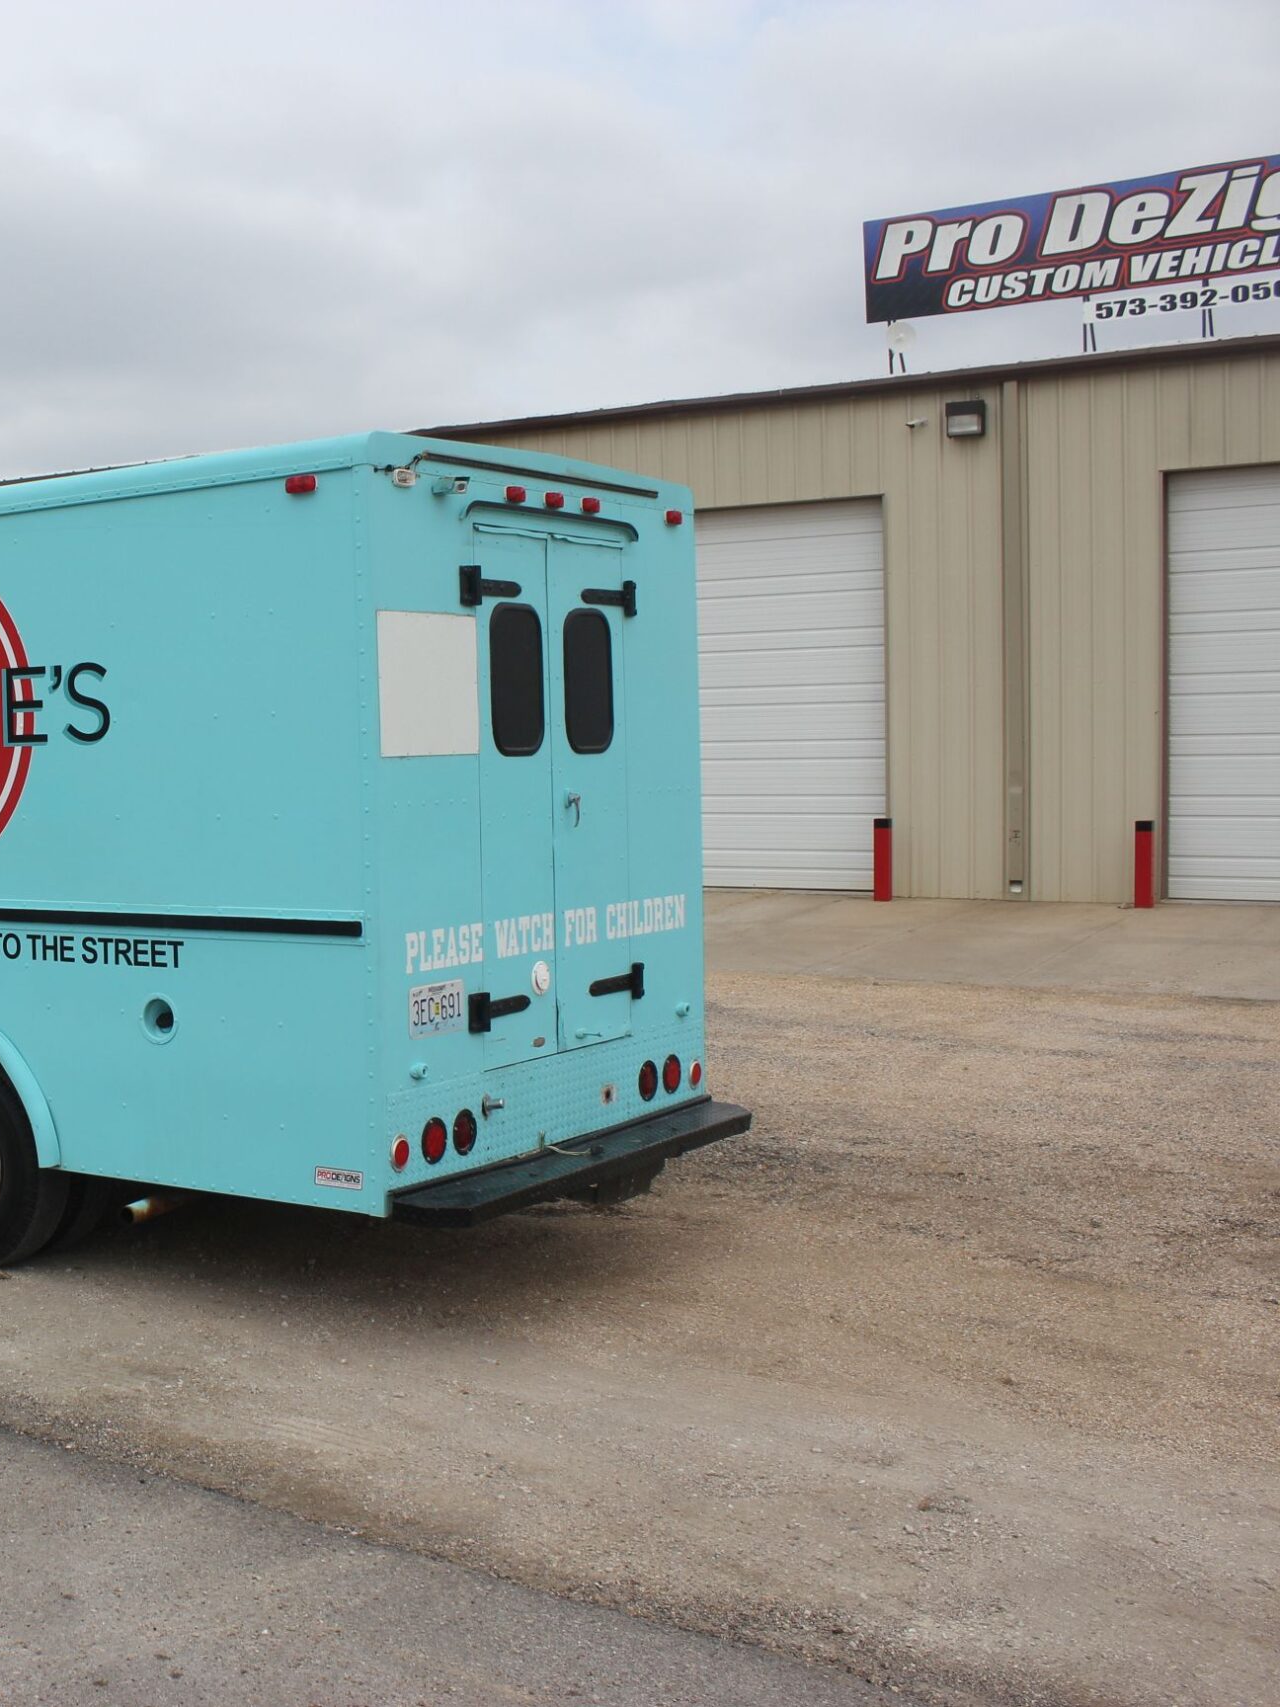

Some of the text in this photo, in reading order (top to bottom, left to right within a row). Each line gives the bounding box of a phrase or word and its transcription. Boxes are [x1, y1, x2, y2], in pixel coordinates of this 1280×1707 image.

[876, 214, 1024, 279] Pro
[947, 259, 1119, 306] CUSTOM
[26, 934, 75, 963] THE
[81, 936, 184, 968] STREET
[405, 894, 685, 974] PLEASE WATCH FOR CHILDREN
[413, 991, 461, 1026] 3EC 691
